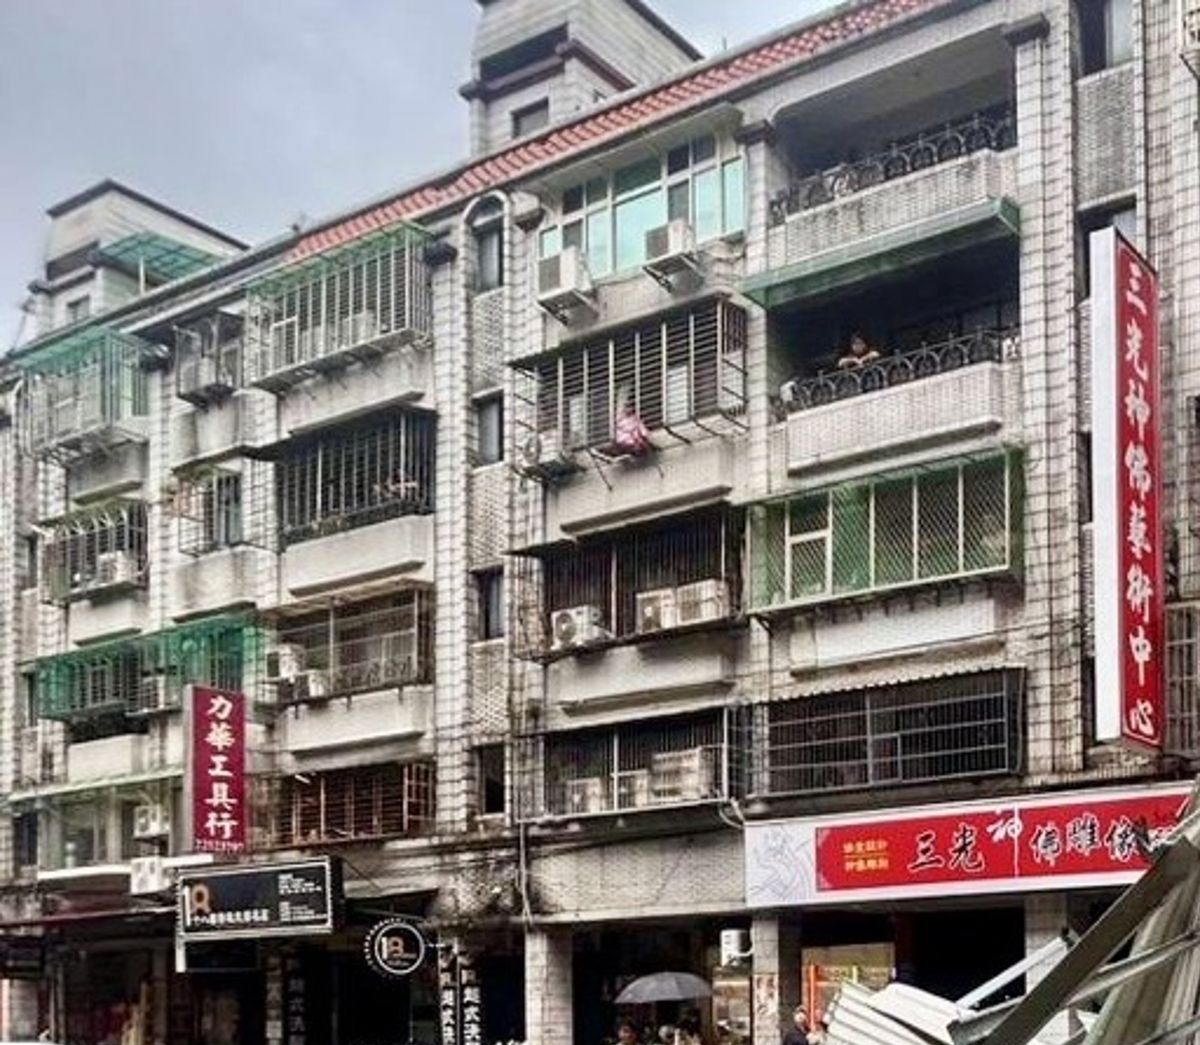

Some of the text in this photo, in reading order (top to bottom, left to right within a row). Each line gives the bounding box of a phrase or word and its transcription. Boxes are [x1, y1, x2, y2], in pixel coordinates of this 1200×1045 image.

[204, 695, 239, 839] 力華工具行
